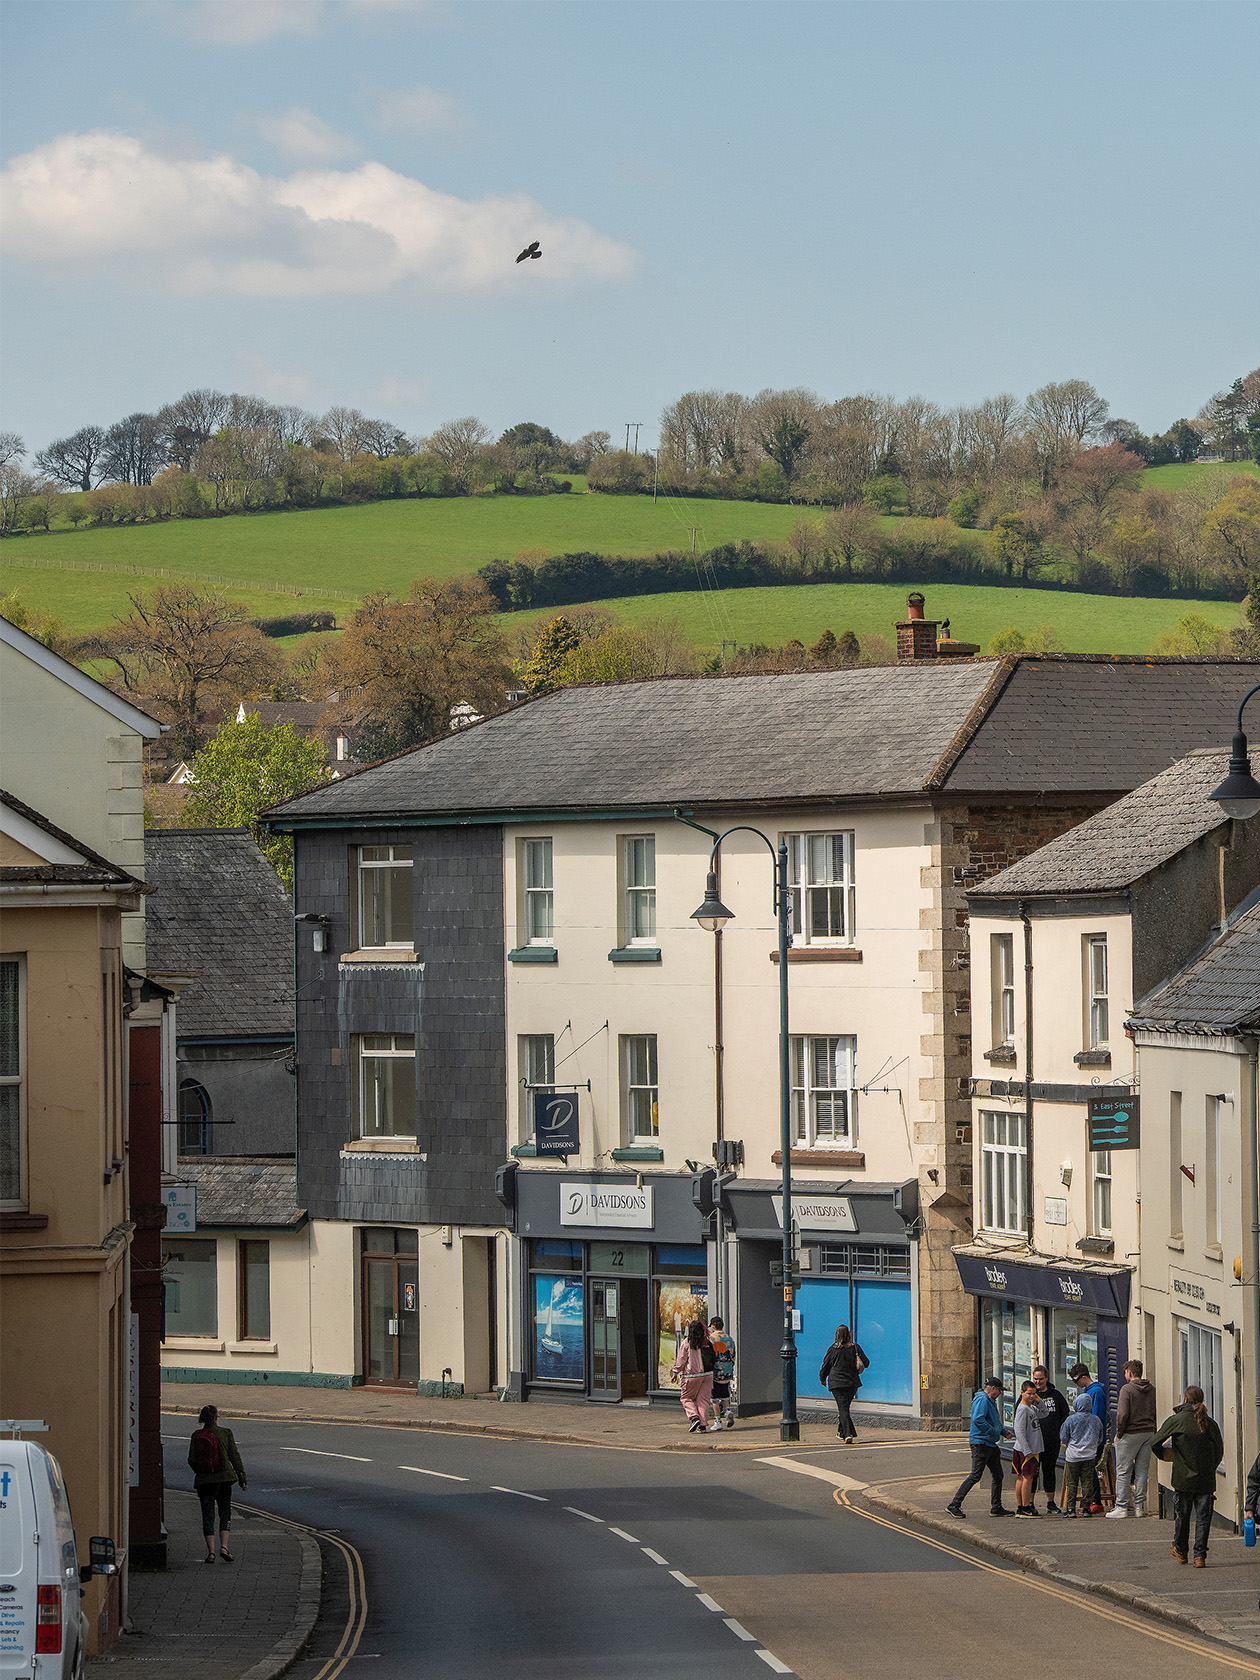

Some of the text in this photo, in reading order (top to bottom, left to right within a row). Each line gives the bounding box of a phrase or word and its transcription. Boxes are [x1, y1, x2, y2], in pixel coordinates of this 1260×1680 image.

[1114, 1101, 1134, 1110] Street
[541, 1141, 575, 1149] DAVIDSONS
[590, 1194, 646, 1210] DAVIDSONS
[799, 1205, 847, 1217] DAVIDSONS
[612, 1251, 624, 1266] 22
